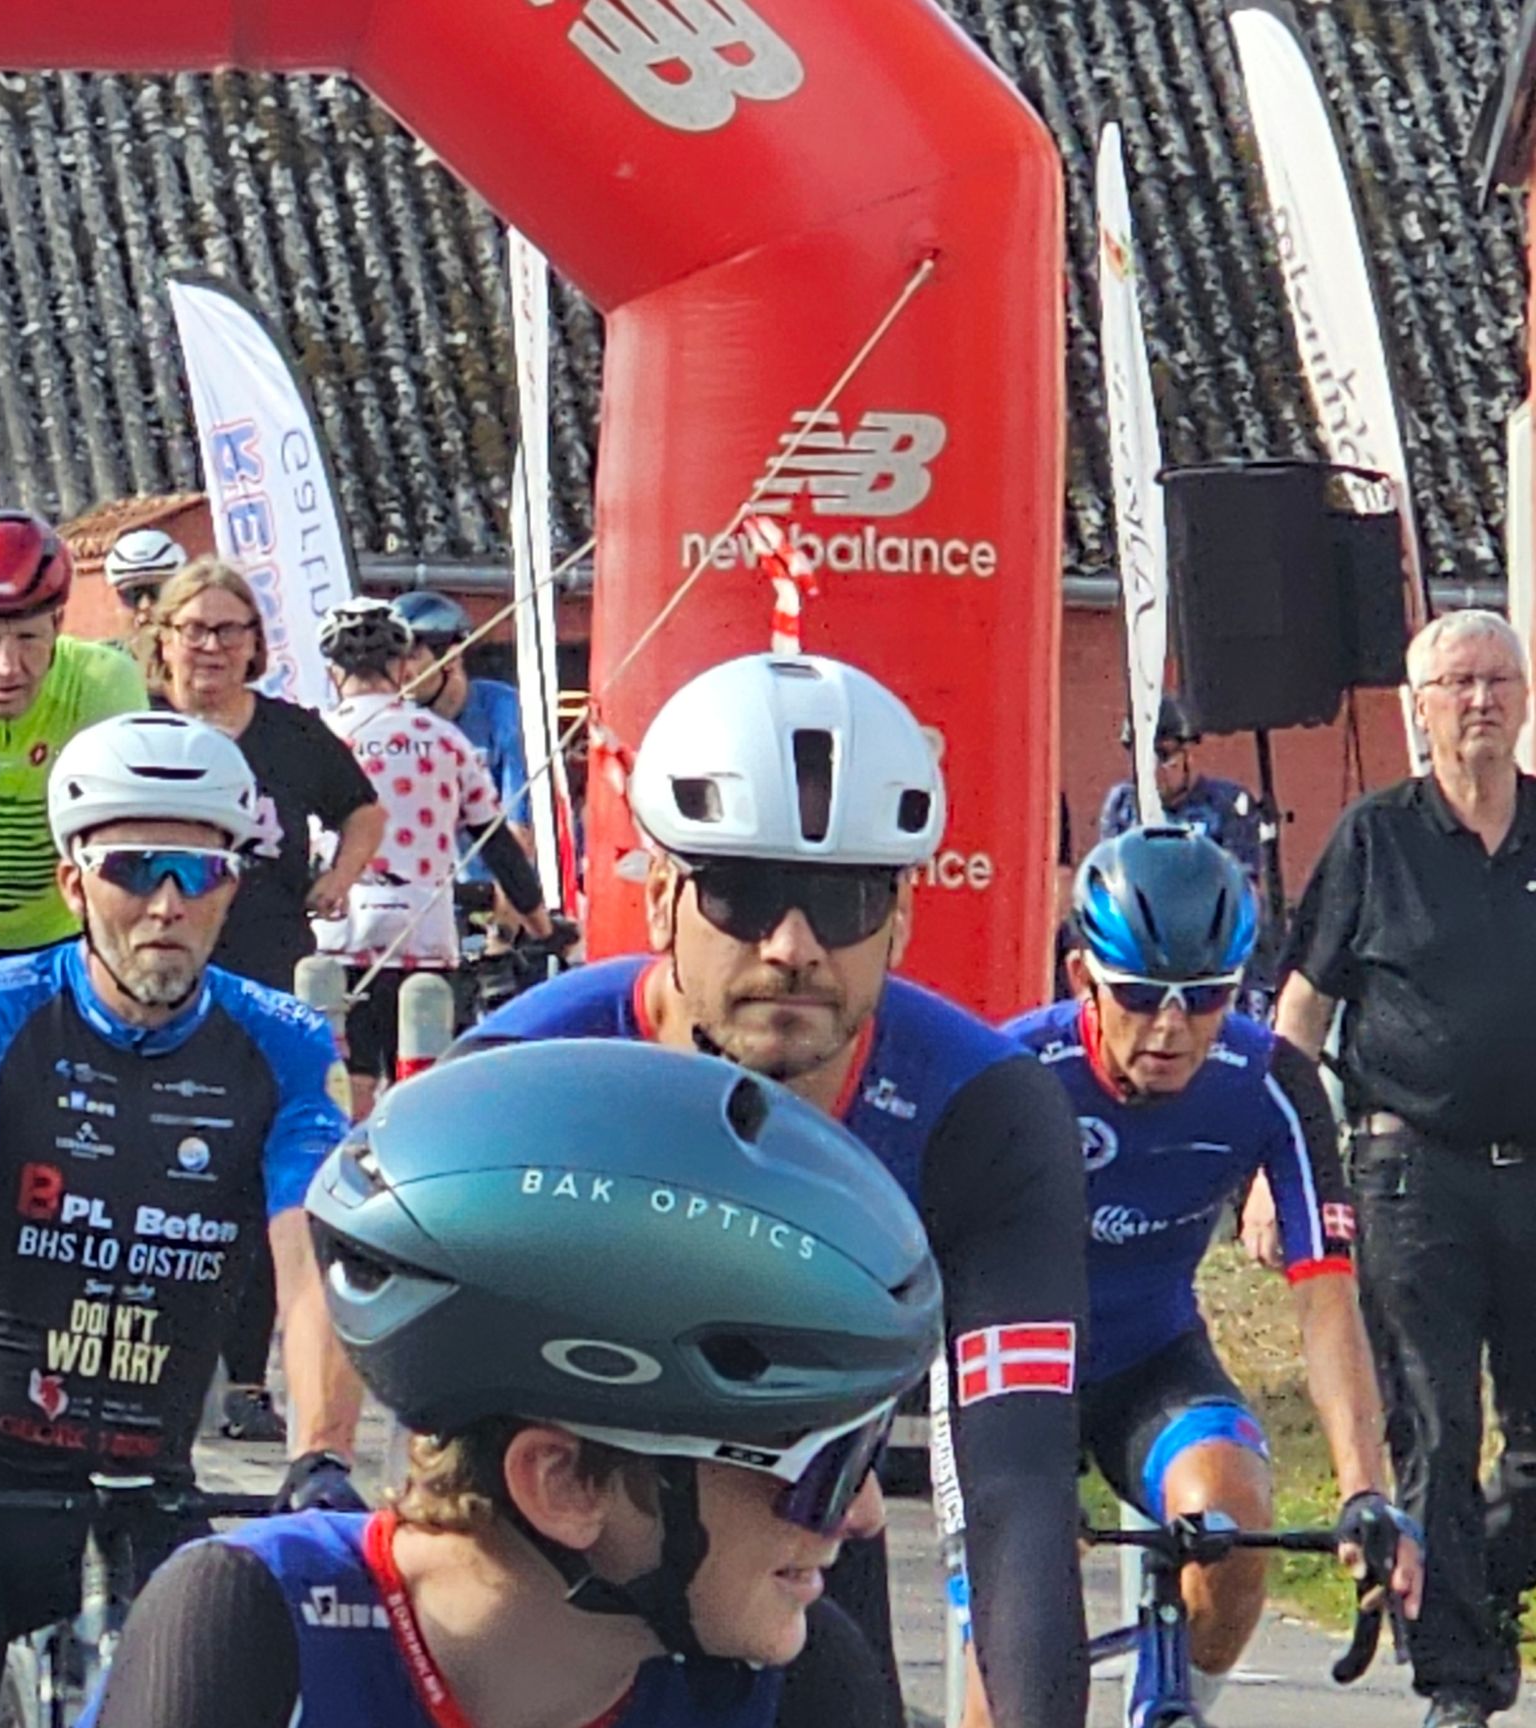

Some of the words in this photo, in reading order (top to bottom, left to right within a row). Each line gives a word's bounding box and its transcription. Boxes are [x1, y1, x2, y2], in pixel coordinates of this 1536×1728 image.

[790, 523, 997, 577] balance
[135, 1204, 239, 1245] Beton
[522, 1168, 613, 1202] BAK
[650, 1189, 817, 1260] OPTICS
[18, 1225, 76, 1263] BHS
[46, 1330, 171, 1386] WORRY
